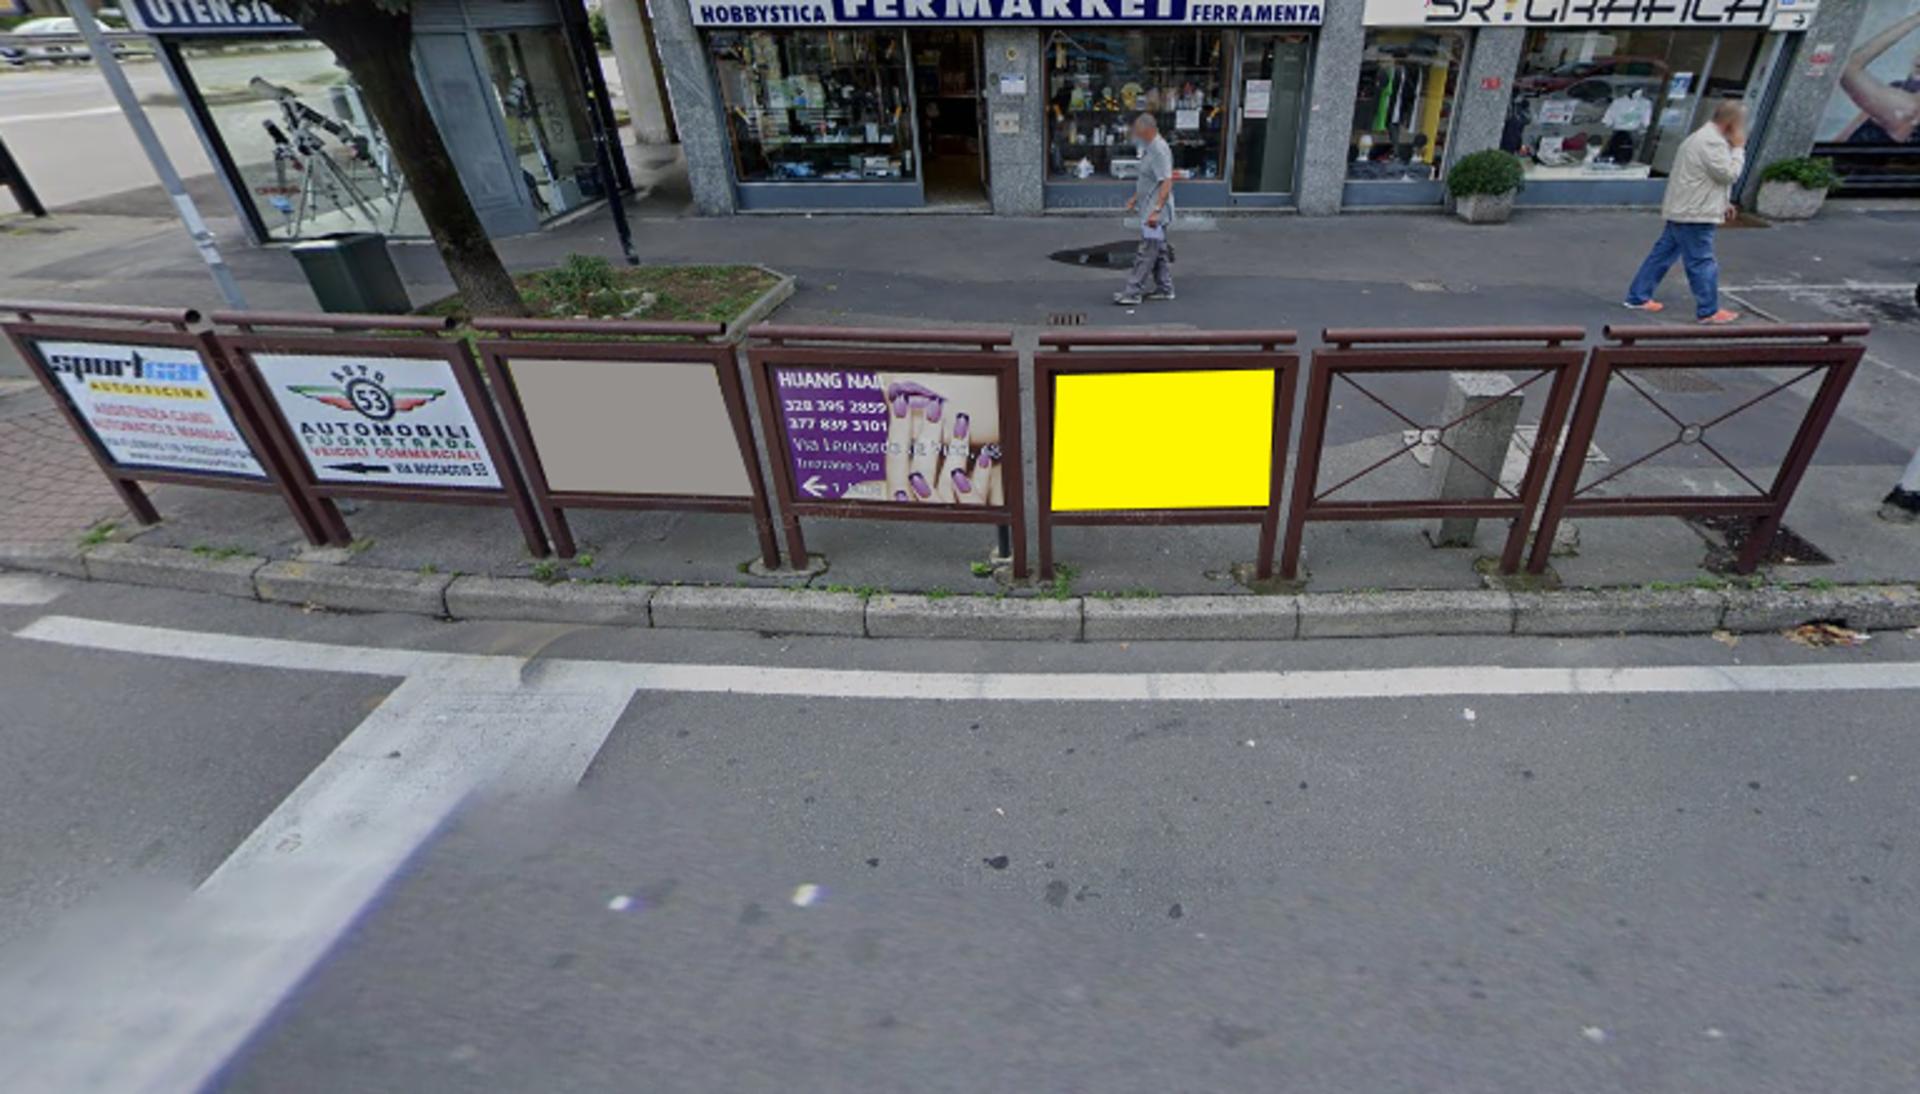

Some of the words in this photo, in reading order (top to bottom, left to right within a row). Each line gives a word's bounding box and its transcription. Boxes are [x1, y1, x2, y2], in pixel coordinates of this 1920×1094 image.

[144, 0, 293, 24] UTENSIL
[700, 4, 826, 23] HOBBYSTICA
[844, 0, 1171, 18] FERMARKET
[1192, 4, 1321, 22] FERRAMENTA
[90, 380, 206, 399] AUTOFFICINA
[778, 372, 843, 390] HUANG
[355, 389, 387, 412] 53
[785, 400, 814, 412] 328
[301, 421, 471, 439] AUTOMOBILI
[820, 419, 849, 431] 839
[851, 420, 888, 432] 3101
[305, 435, 477, 450] FUORISTRADA
[793, 438, 819, 452] Via
[310, 446, 370, 458] VEICOLI
[374, 448, 482, 461] COMMERCIALI
